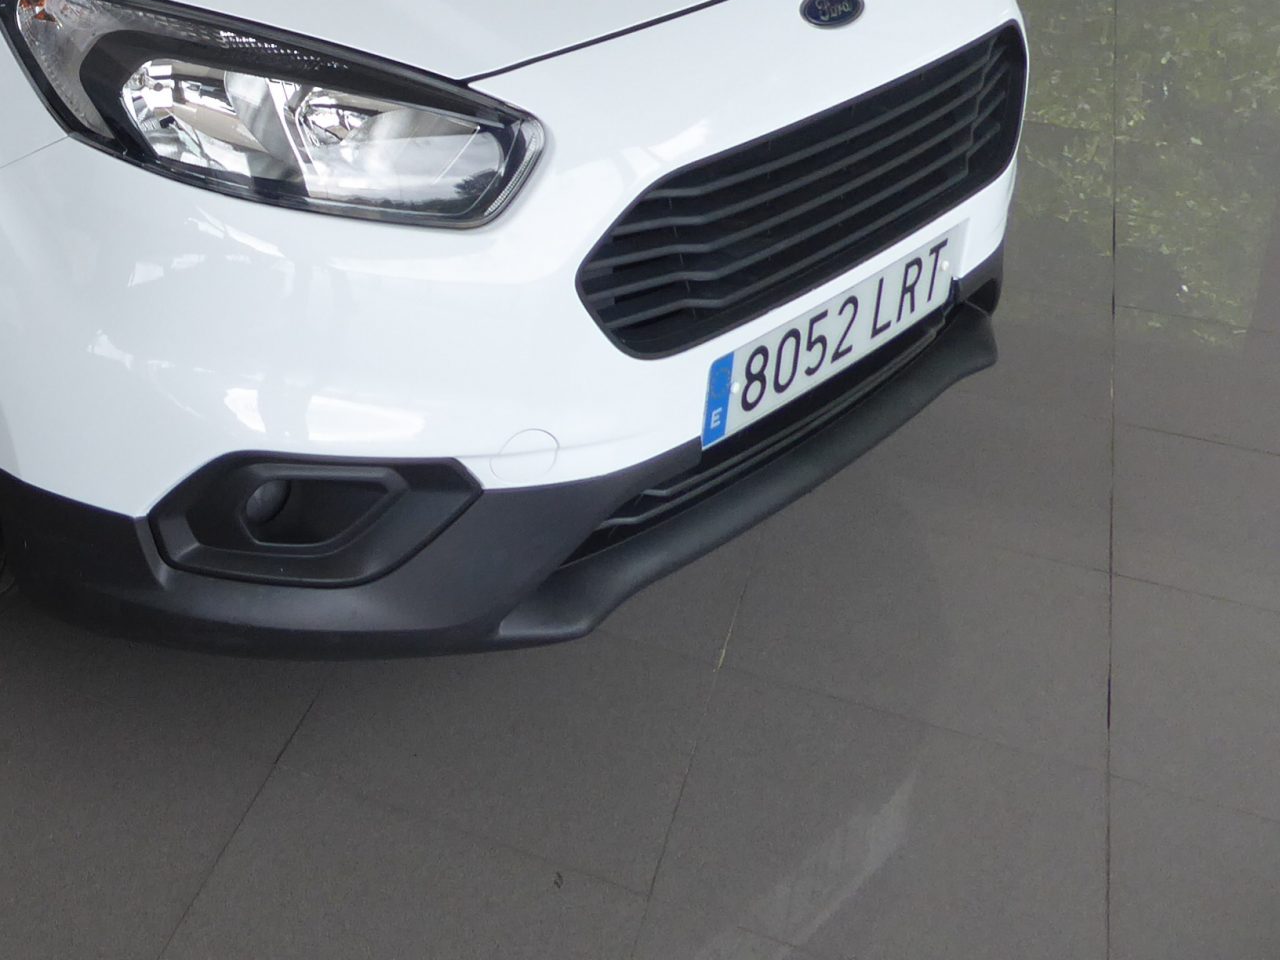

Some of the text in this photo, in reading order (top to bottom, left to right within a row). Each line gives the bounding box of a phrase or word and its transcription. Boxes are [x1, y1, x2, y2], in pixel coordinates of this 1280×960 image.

[741, 238, 948, 412] 8052 LRT
[710, 406, 723, 429] E
